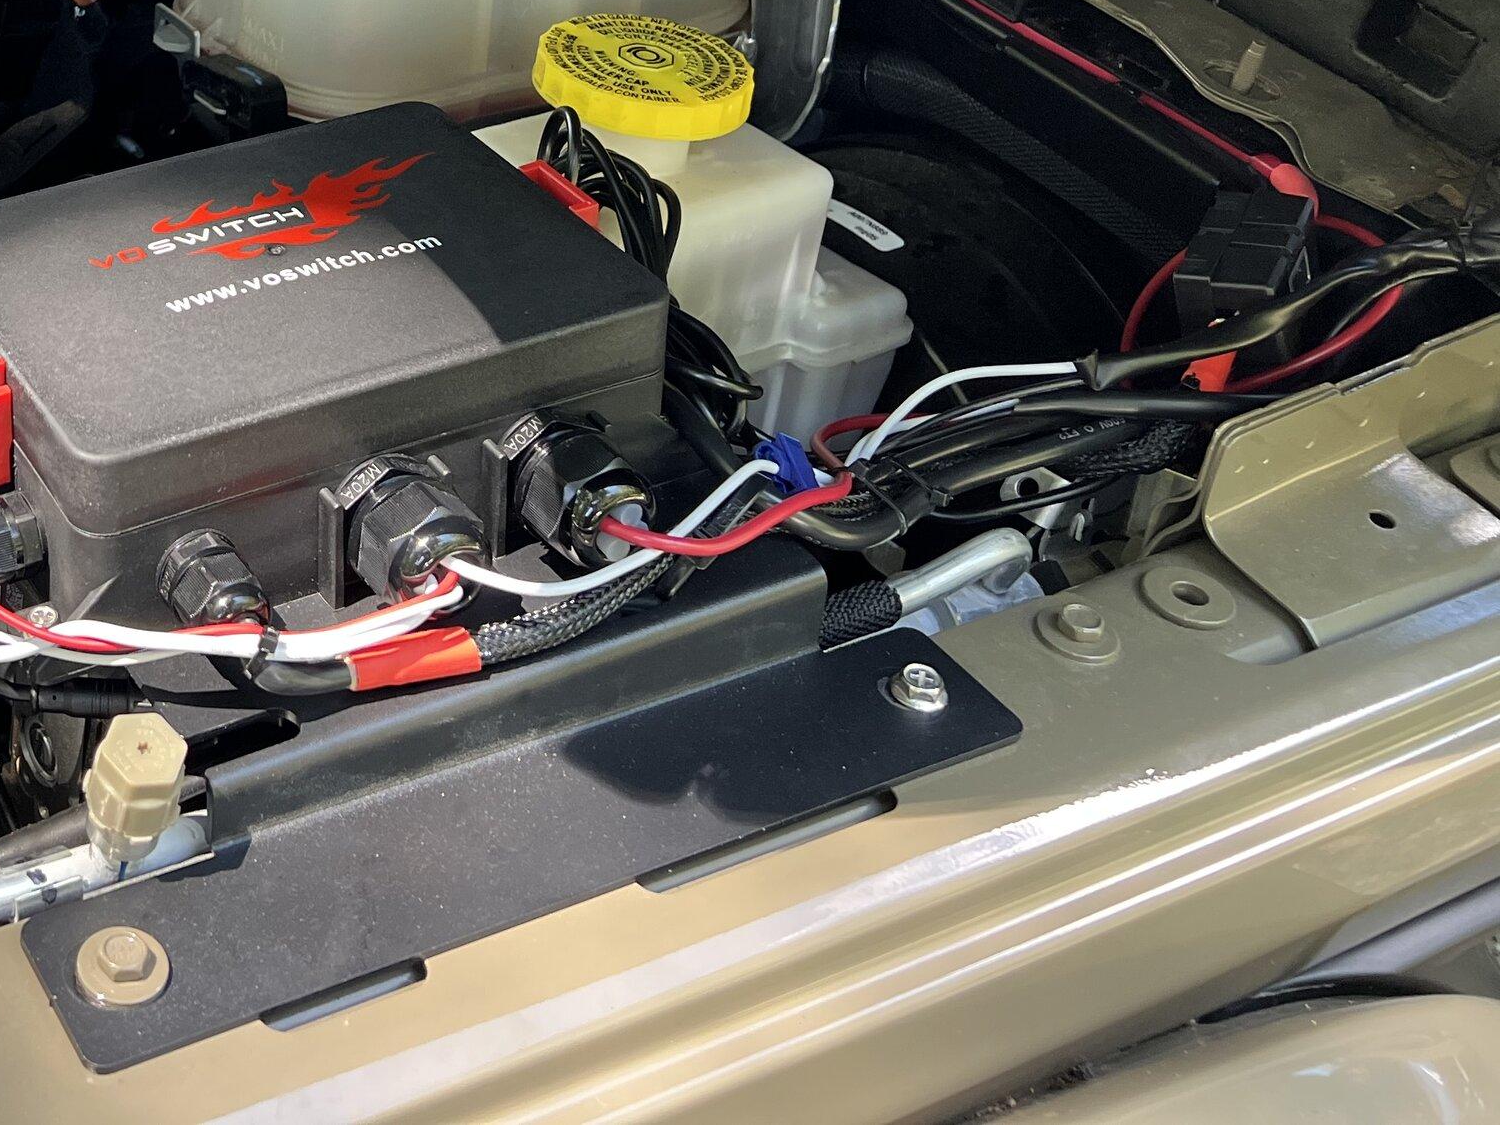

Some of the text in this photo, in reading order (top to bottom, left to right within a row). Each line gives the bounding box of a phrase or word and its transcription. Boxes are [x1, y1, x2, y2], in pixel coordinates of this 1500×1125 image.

[576, 43, 649, 87] CLEAN FILLER CAP
[571, 72, 615, 92] SEALED
[612, 87, 681, 103] CONTAINER
[610, 80, 636, 91] USE
[640, 86, 673, 96] ONLY
[87, 207, 305, 270] VOSWITCH
[165, 233, 442, 314] www.voswitch.com
[504, 415, 543, 451] M20A
[340, 463, 382, 500] M20A
